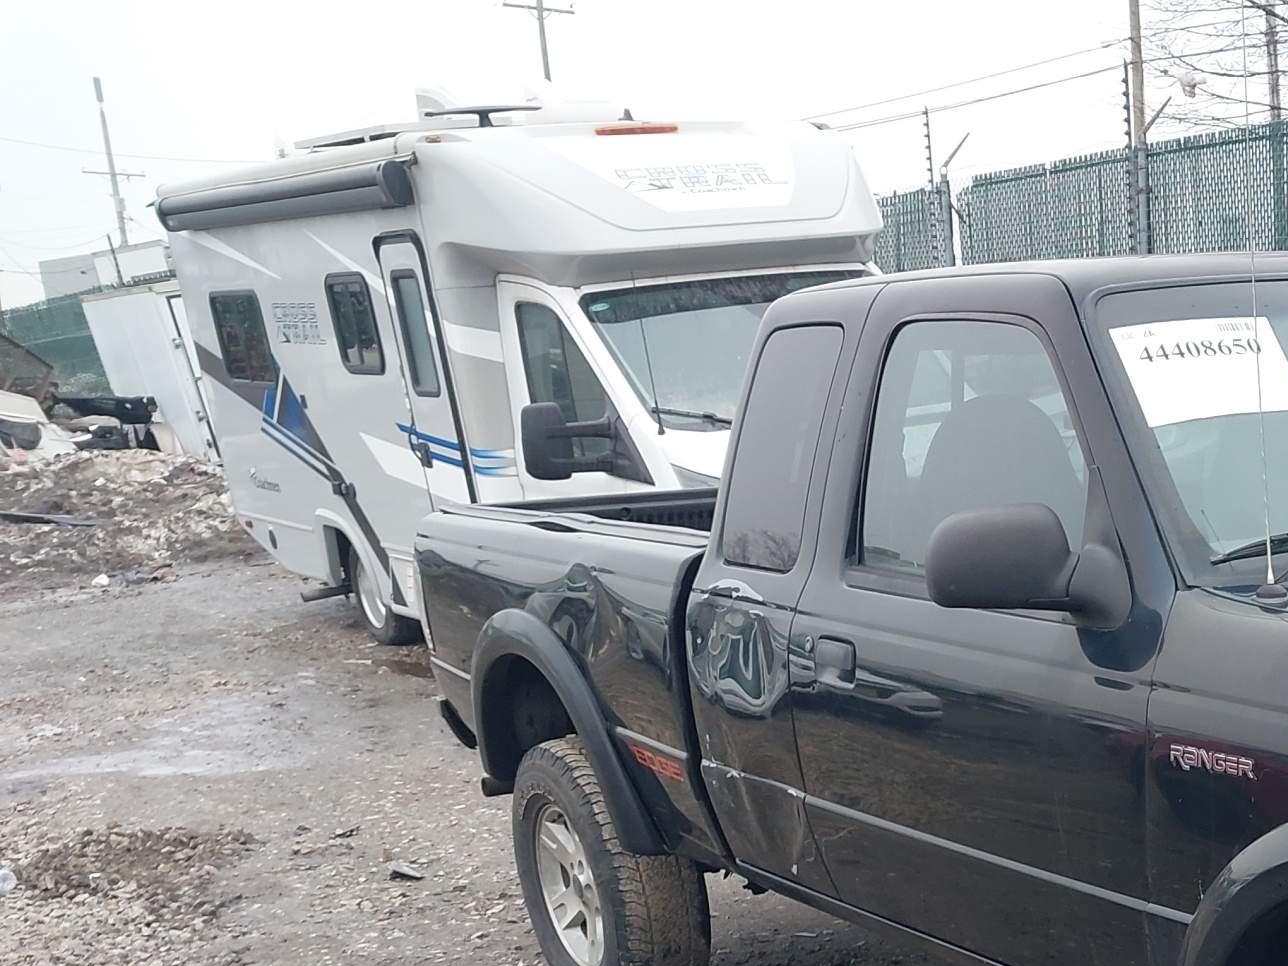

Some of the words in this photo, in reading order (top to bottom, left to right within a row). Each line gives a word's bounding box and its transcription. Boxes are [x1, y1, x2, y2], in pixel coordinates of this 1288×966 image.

[1139, 338, 1262, 362] 44408650
[631, 745, 684, 782] EDGE
[1169, 743, 1258, 781] RANGER
